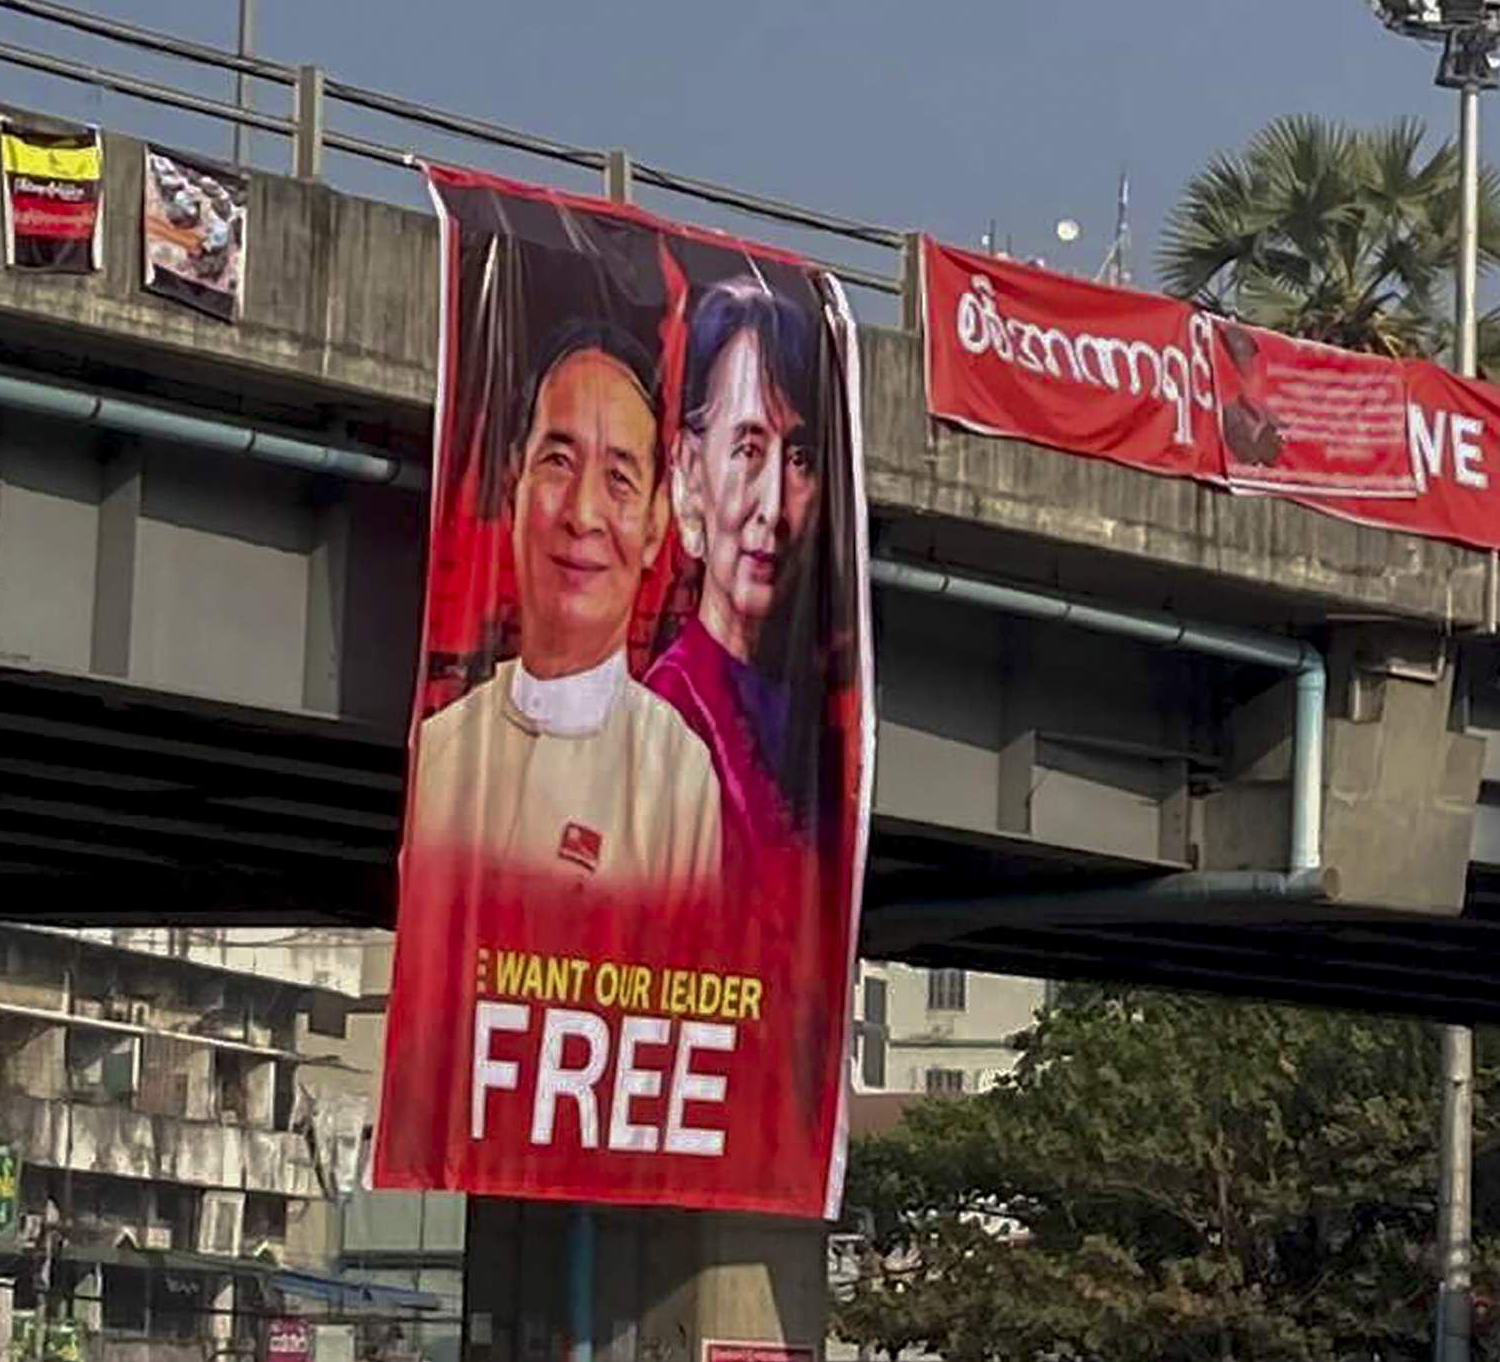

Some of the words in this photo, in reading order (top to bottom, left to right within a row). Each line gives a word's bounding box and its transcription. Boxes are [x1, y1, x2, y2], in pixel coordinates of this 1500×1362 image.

[496, 950, 590, 1002] WANT
[596, 962, 652, 1009] OUR
[470, 999, 737, 1157] FREE
